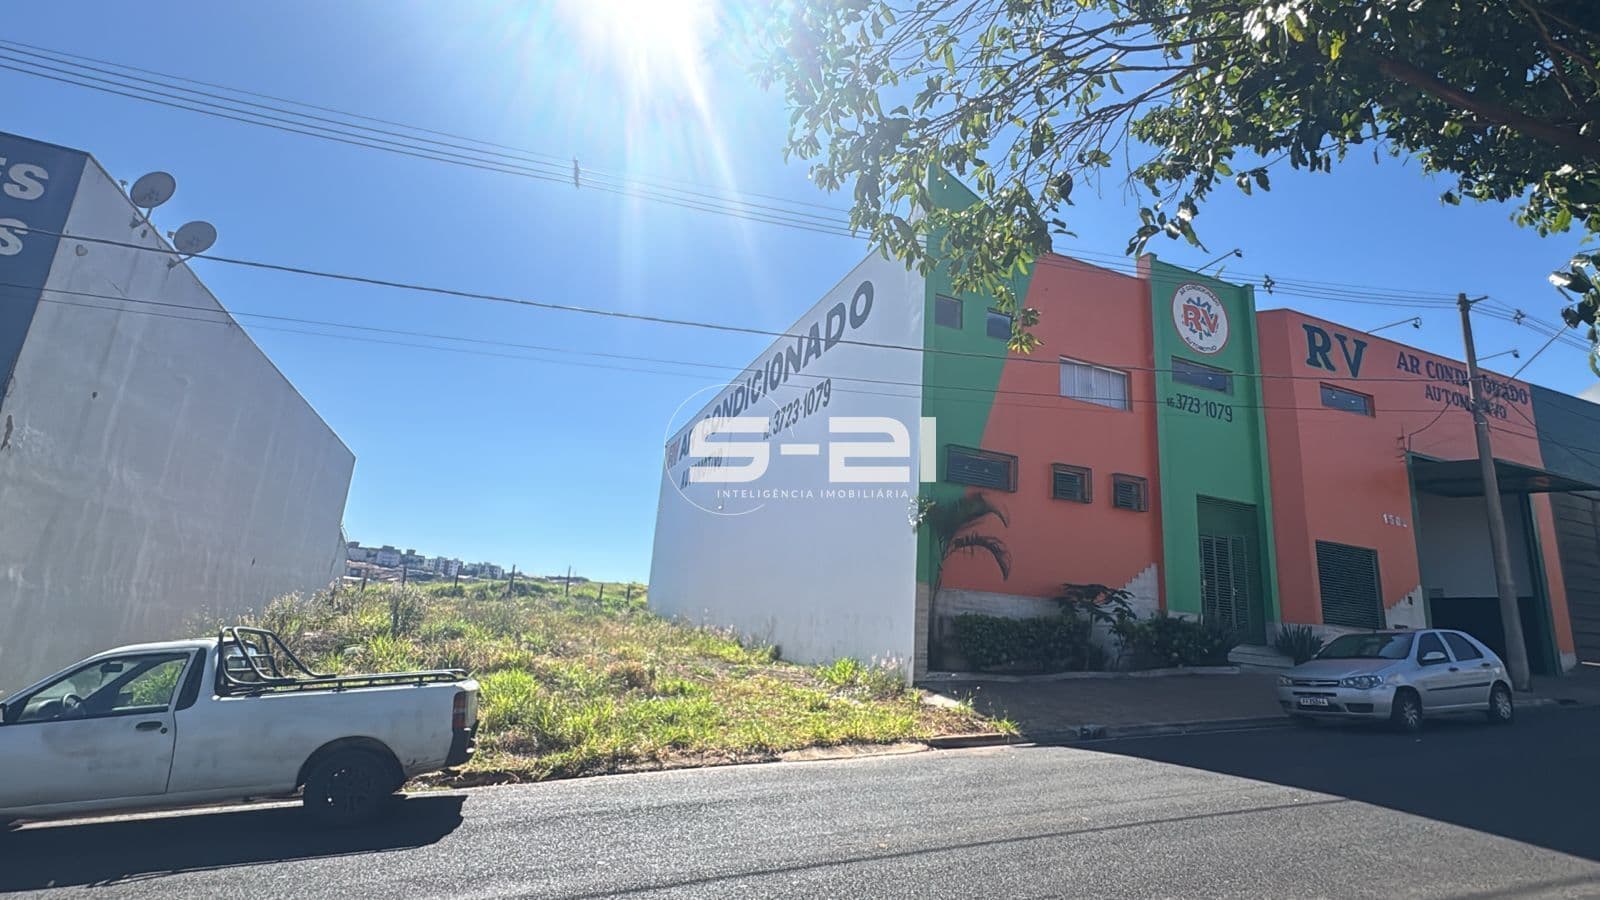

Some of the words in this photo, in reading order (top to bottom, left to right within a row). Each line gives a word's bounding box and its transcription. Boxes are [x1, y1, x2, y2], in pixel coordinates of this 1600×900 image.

[0, 157, 48, 200] S
[1183, 303, 1218, 333] RV
[702, 280, 874, 442] ONDICIONADO
[1302, 323, 1368, 378] RV
[1397, 351, 1421, 375] AR
[773, 378, 832, 436] 3723-1079
